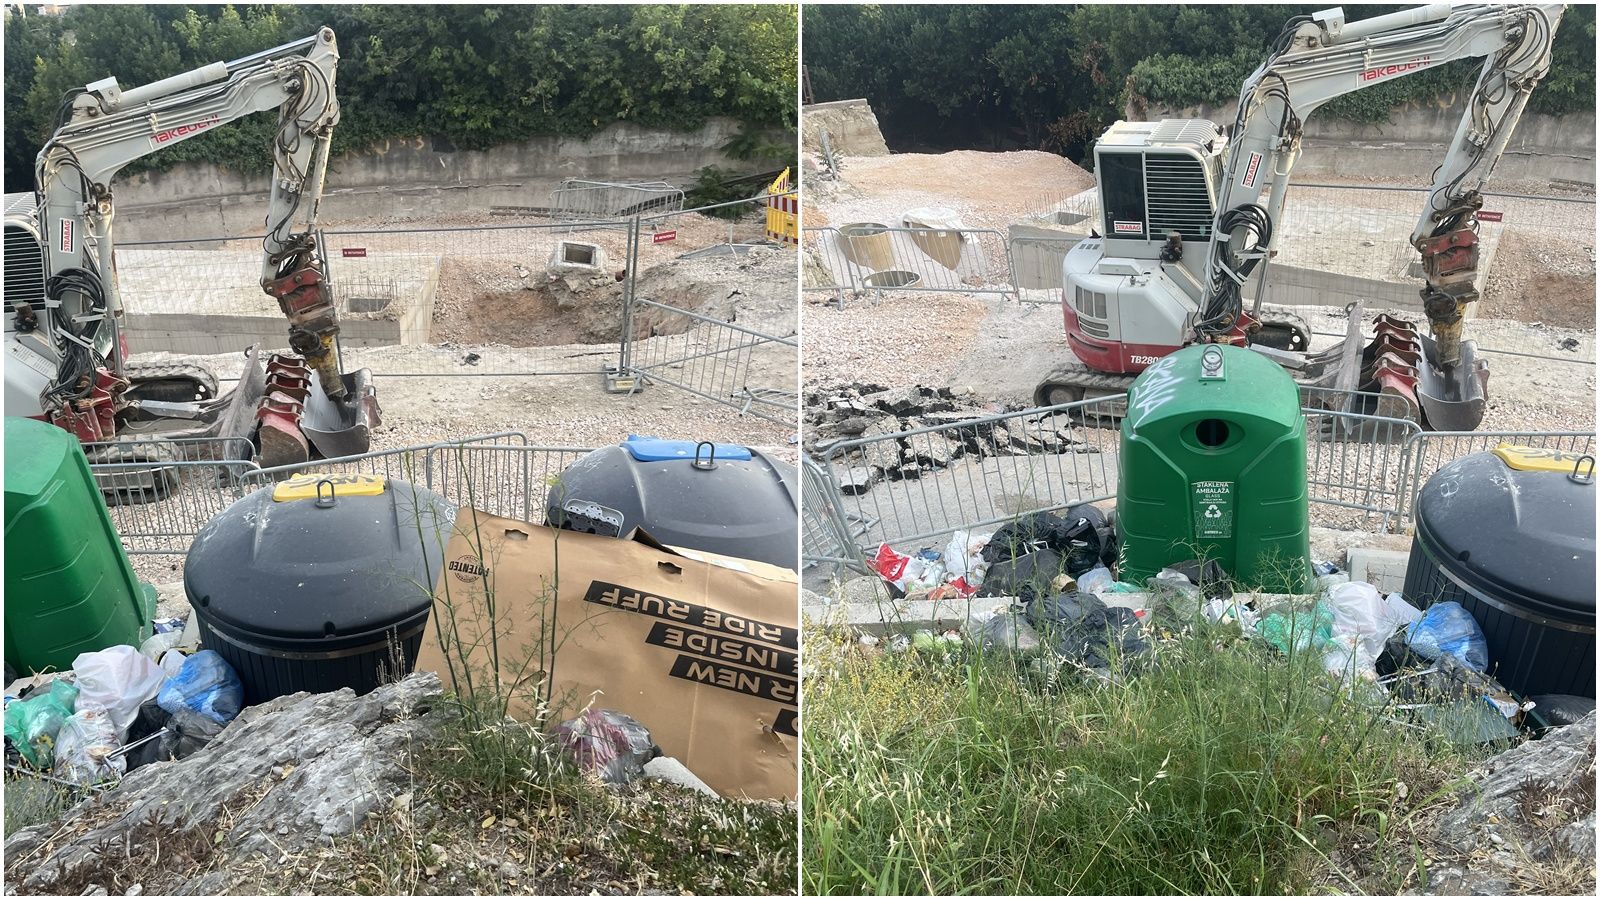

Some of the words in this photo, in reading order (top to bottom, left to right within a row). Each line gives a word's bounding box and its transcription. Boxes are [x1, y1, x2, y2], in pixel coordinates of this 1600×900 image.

[1245, 154, 1260, 187] STRABAG
[1115, 223, 1141, 231] STRABAG
[1130, 355, 1162, 365] TB280
[600, 588, 690, 621] RUFF
[703, 609, 781, 642] RIDE
[663, 627, 779, 669] INSIDE
[686, 661, 761, 694] NEW
